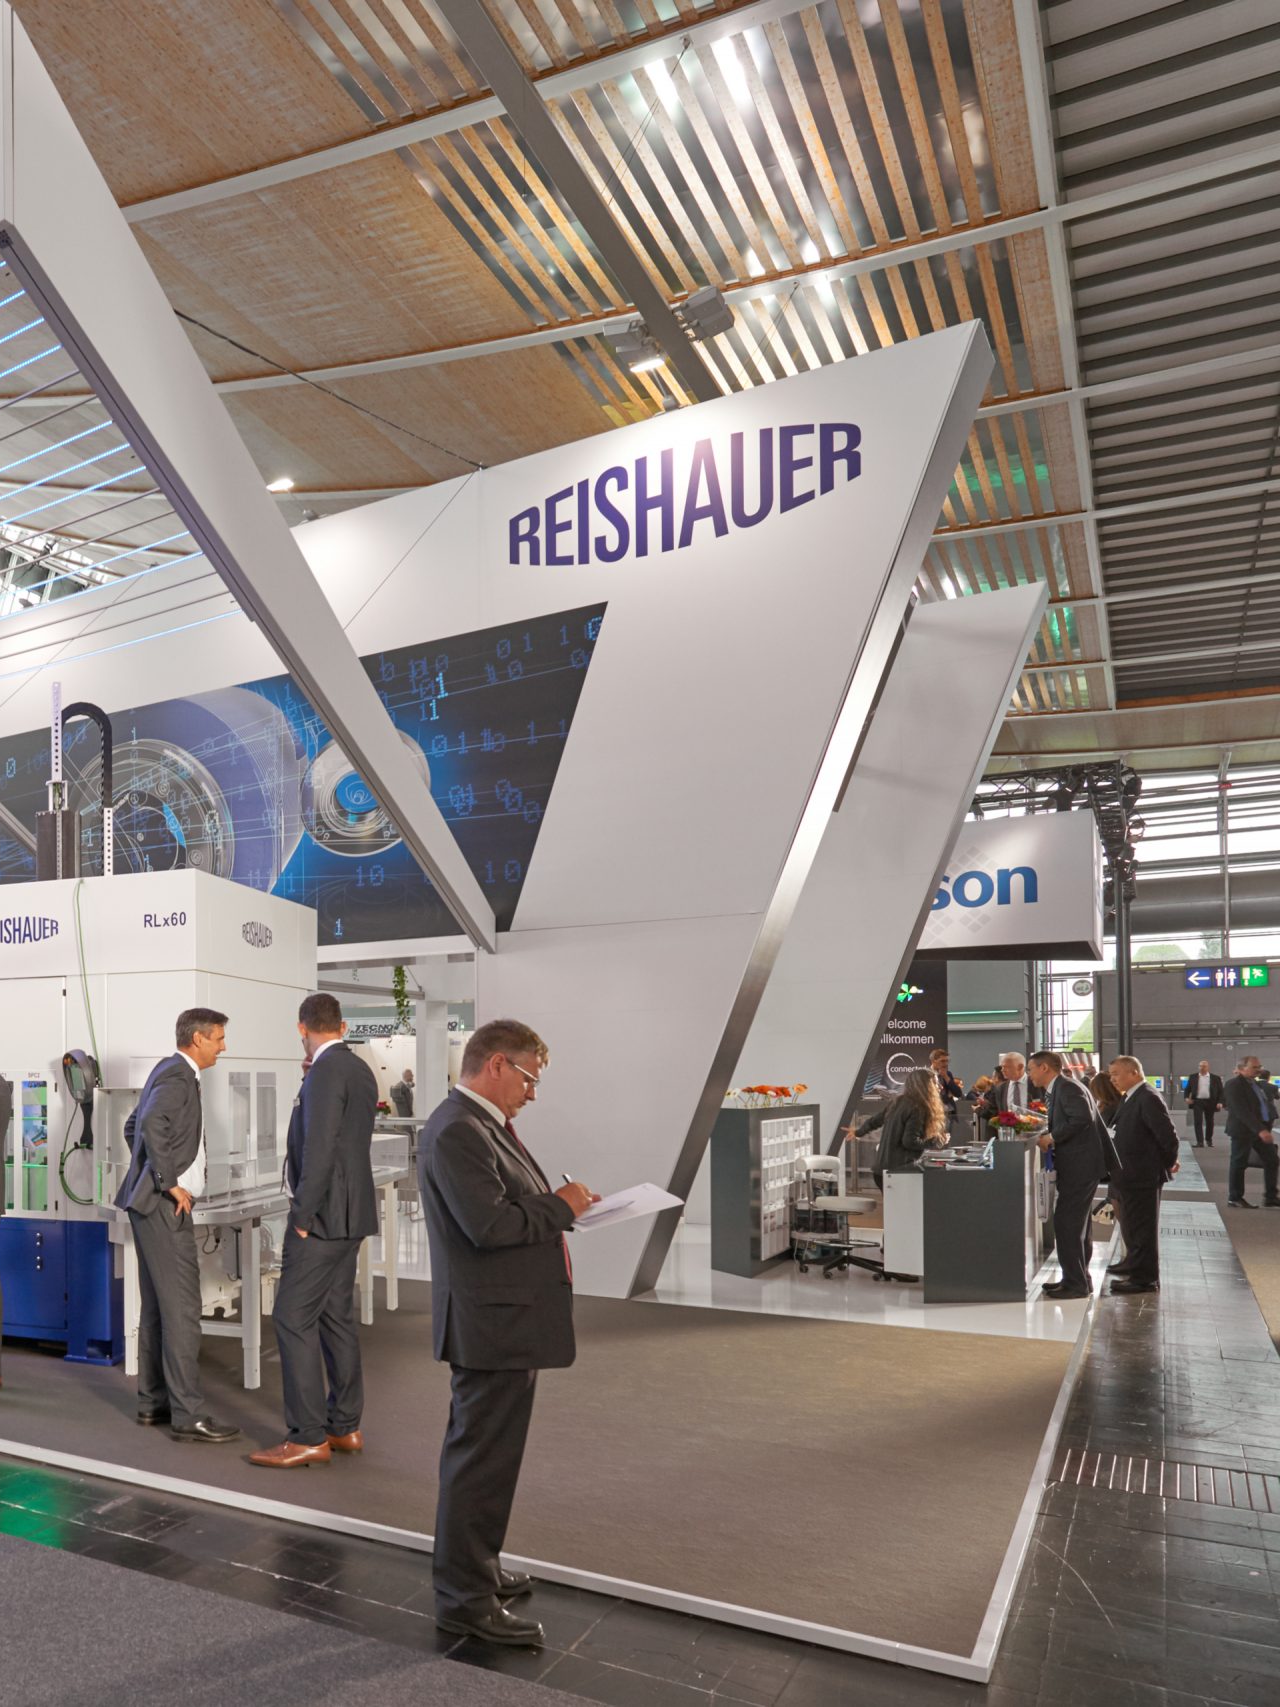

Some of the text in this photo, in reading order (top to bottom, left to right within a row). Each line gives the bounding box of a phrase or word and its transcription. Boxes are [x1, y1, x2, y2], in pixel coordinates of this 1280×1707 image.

[509, 423, 862, 566] REISHAUER
[931, 866, 1039, 911] son
[143, 911, 187, 928] RLx60
[242, 921, 273, 948] REISHAUER
[354, 1024, 394, 1032] TECNO
[887, 1018, 927, 1029] elcome
[880, 1033, 935, 1044] llkommen
